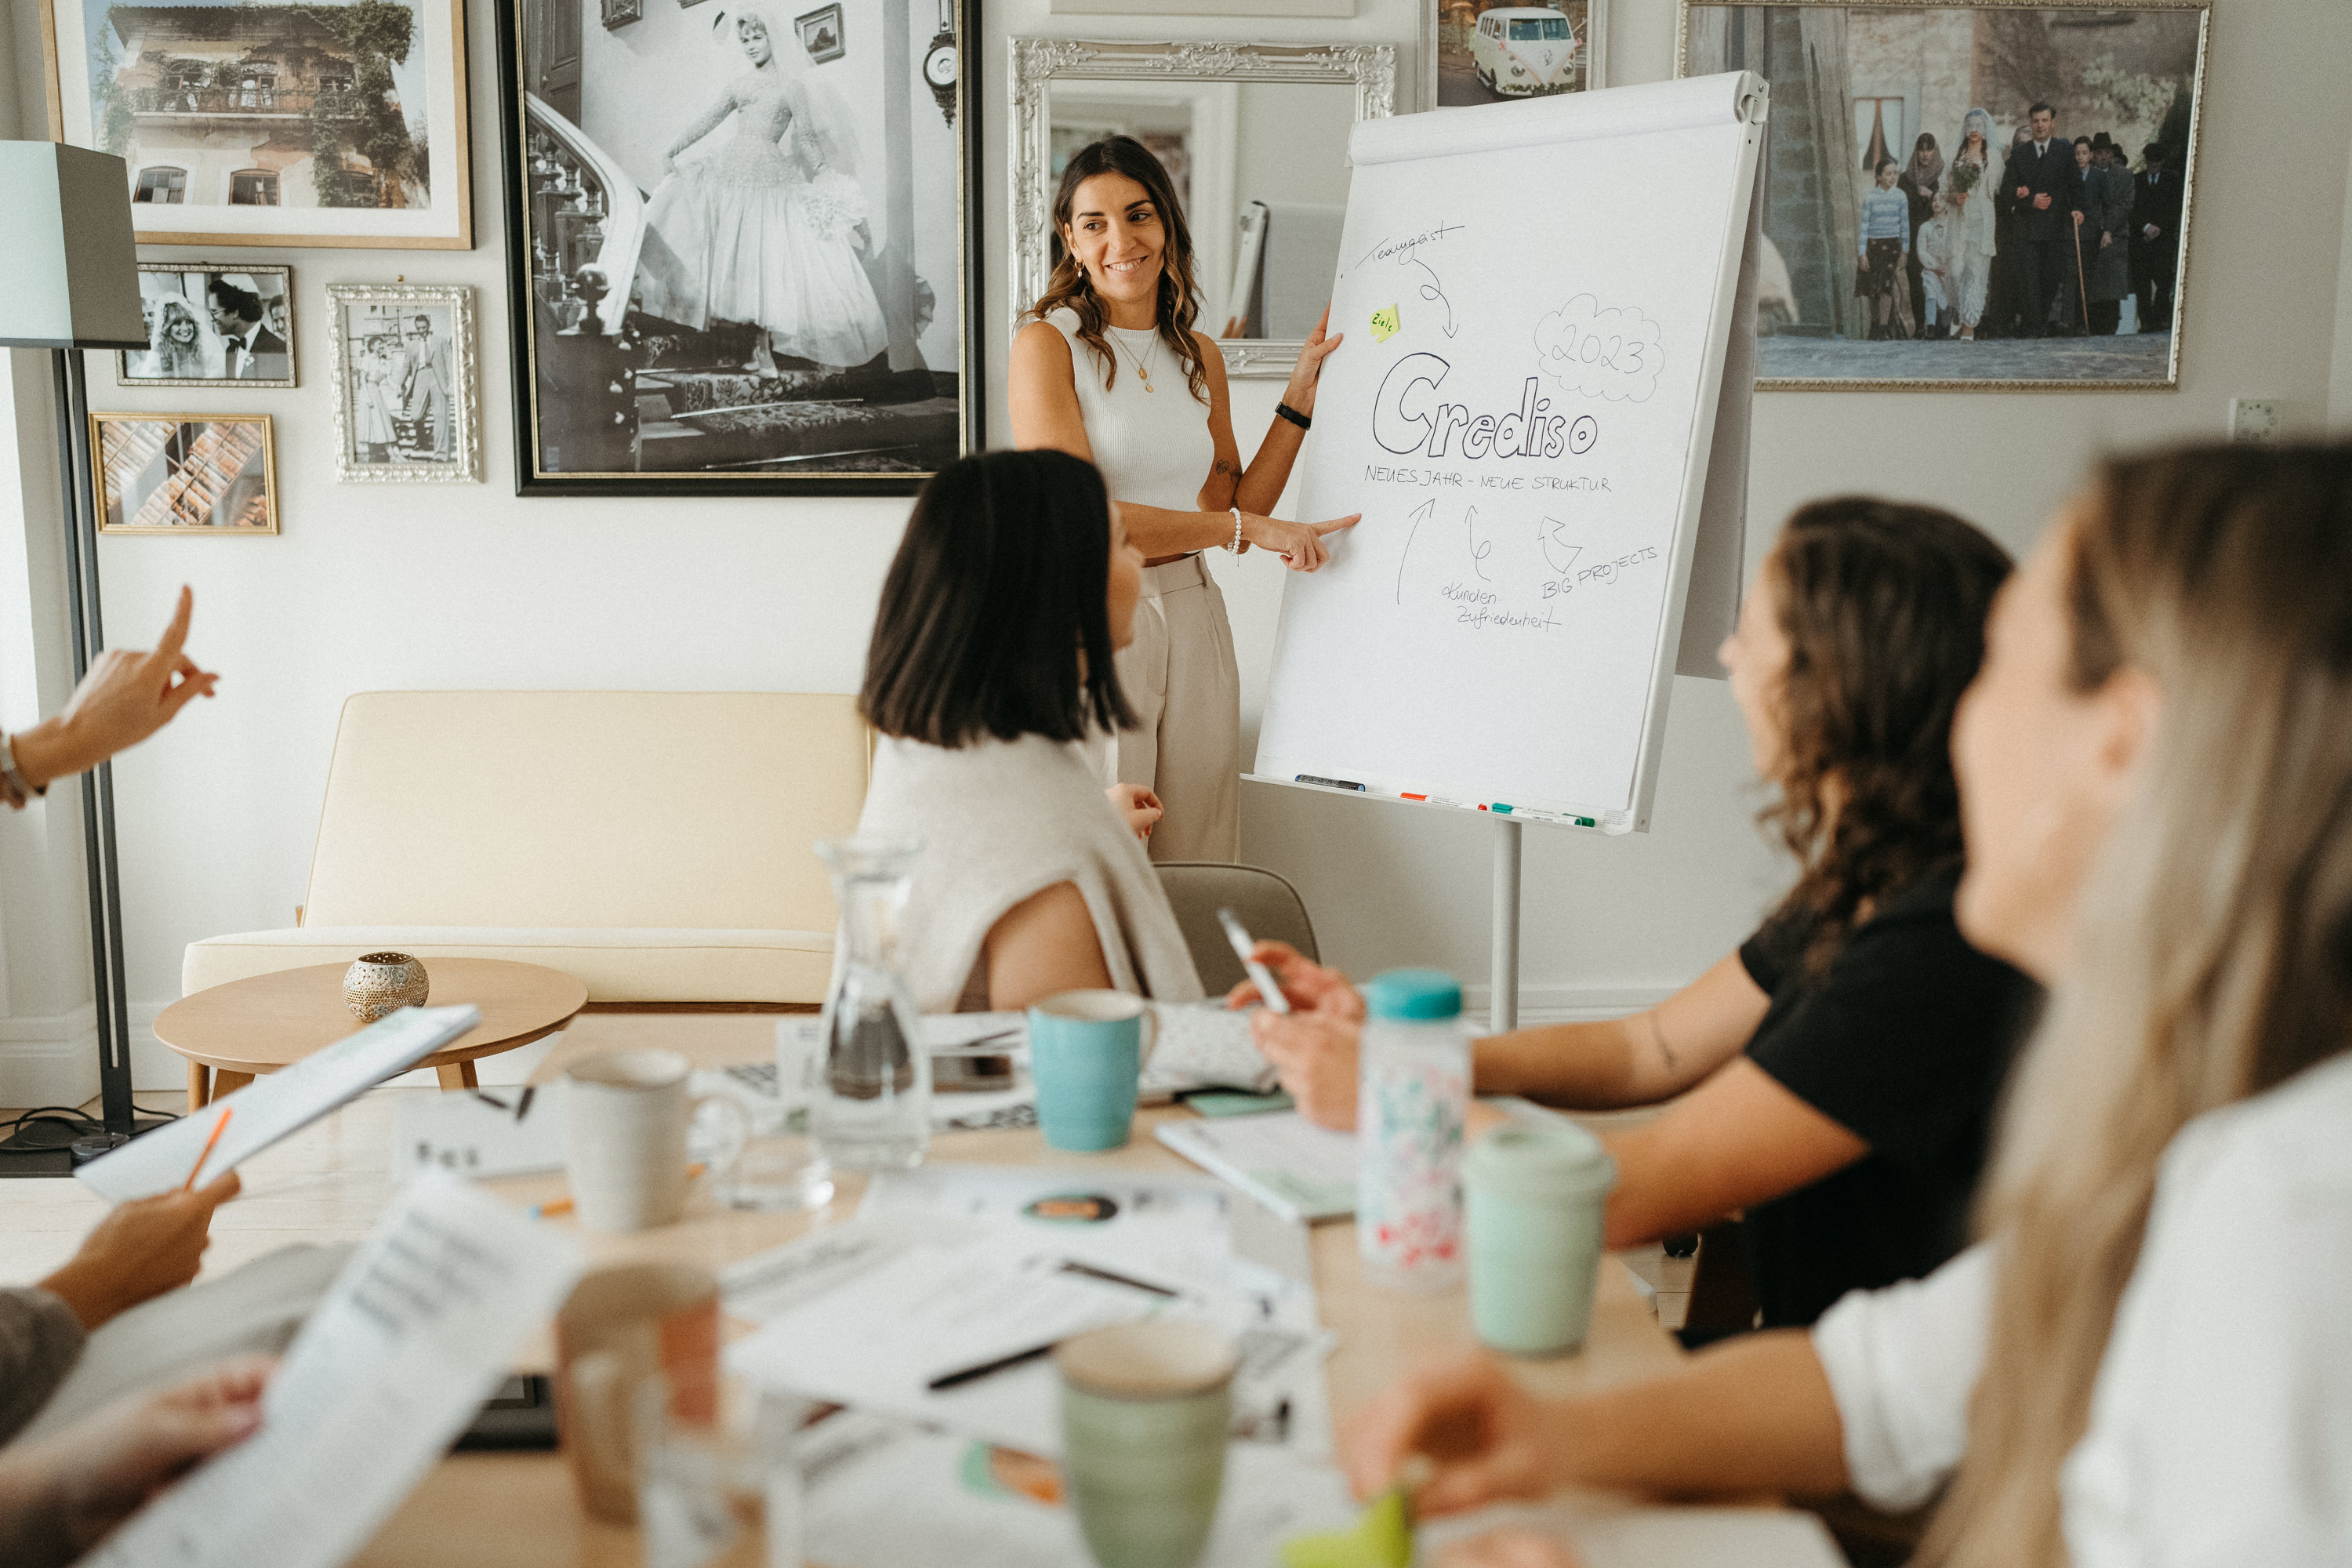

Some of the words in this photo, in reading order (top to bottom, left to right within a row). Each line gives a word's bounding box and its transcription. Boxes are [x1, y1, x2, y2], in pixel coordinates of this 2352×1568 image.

[1355, 220, 1465, 270] Teamgeist
[1372, 313, 1392, 332] Ziele
[1552, 324, 1645, 374] 2023
[1373, 352, 1598, 459] Crediso
[1365, 465, 1417, 483] NEUES
[1419, 470, 1462, 488] JAHR
[1480, 475, 1525, 490] NEUE
[1531, 477, 1612, 492] STRUKTUR
[1541, 577, 1573, 599] BIG
[1577, 547, 1657, 586] PROJECTS
[1457, 605, 1563, 632] Zufriedenheit
